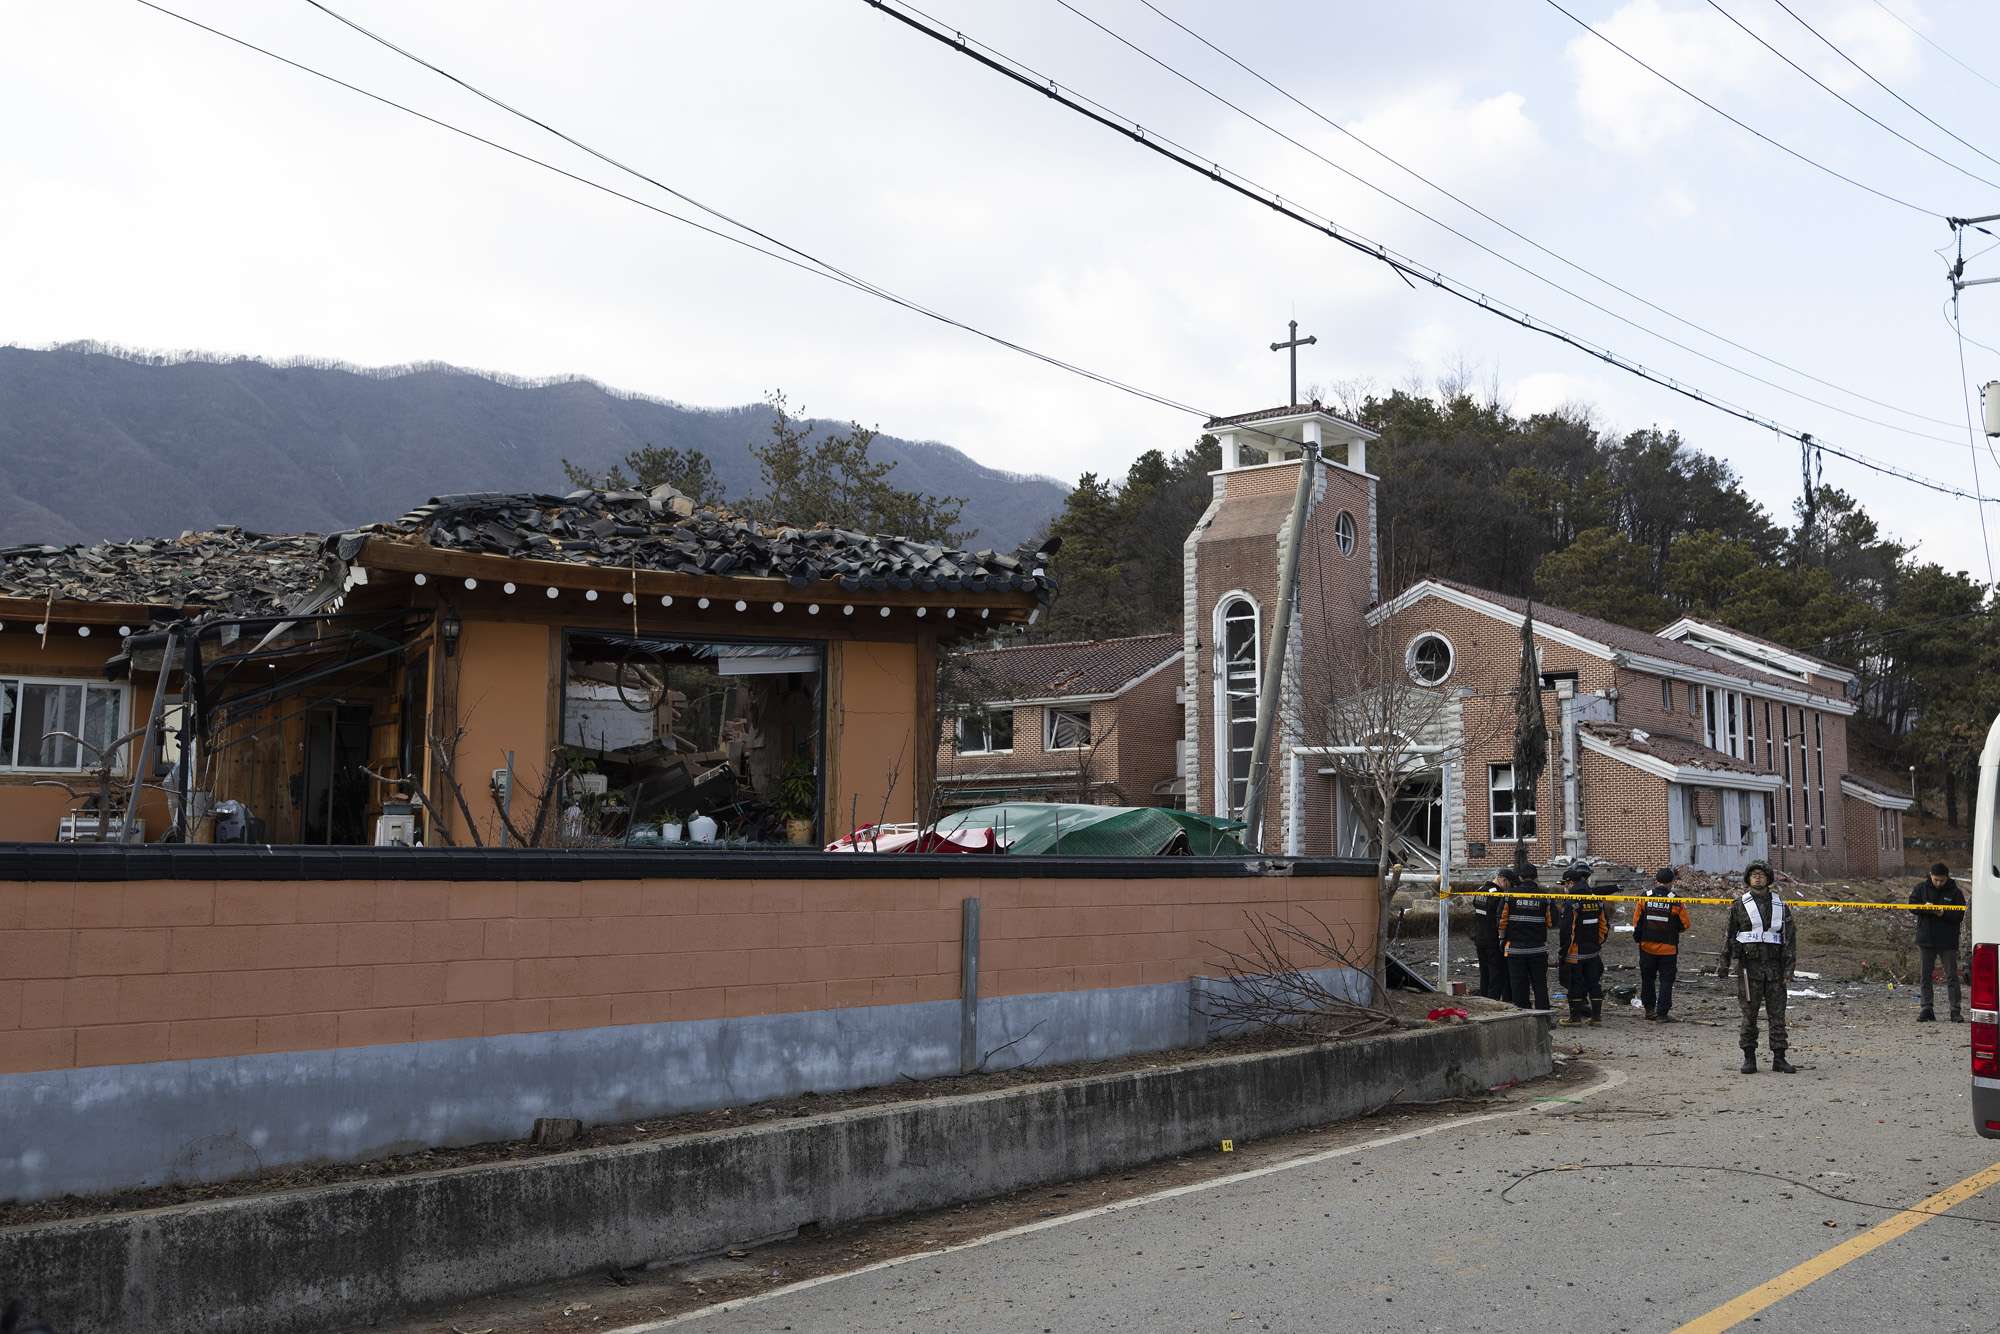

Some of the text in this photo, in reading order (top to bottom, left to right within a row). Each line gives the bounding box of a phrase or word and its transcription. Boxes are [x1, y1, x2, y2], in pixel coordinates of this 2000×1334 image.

[1516, 899, 1540, 907] 화재조사
[1647, 901, 1669, 909] 화재조사
[1746, 933, 1758, 941] 군사
